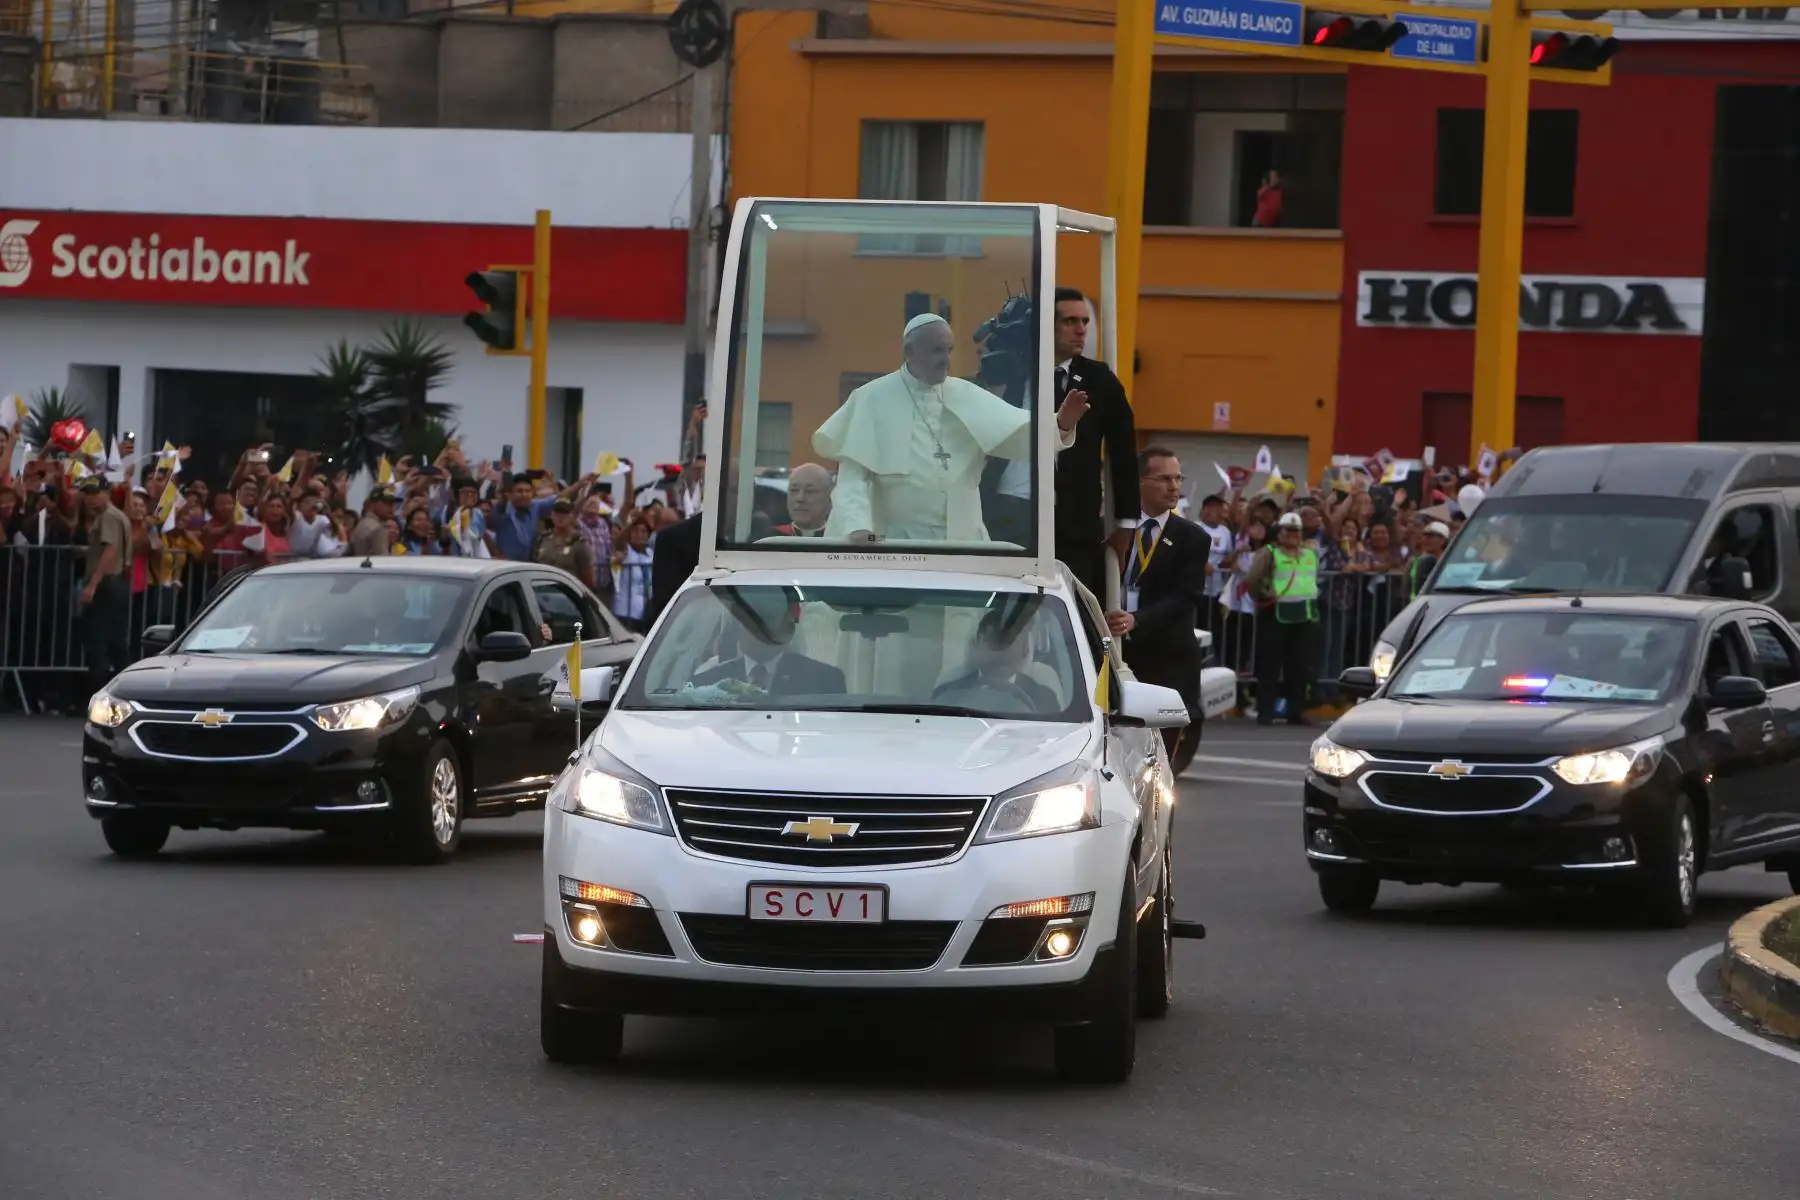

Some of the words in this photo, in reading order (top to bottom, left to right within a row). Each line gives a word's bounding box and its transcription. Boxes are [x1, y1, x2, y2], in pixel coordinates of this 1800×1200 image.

[1160, 5, 1180, 23] AV.
[1183, 7, 1238, 29] GUZMÁN
[1240, 12, 1293, 34] BLANCO
[1403, 21, 1472, 39] UNICIPALIDAD
[1416, 40, 1430, 54] DE
[1432, 41, 1455, 56] LIMA
[51, 233, 311, 285] Scotiabank
